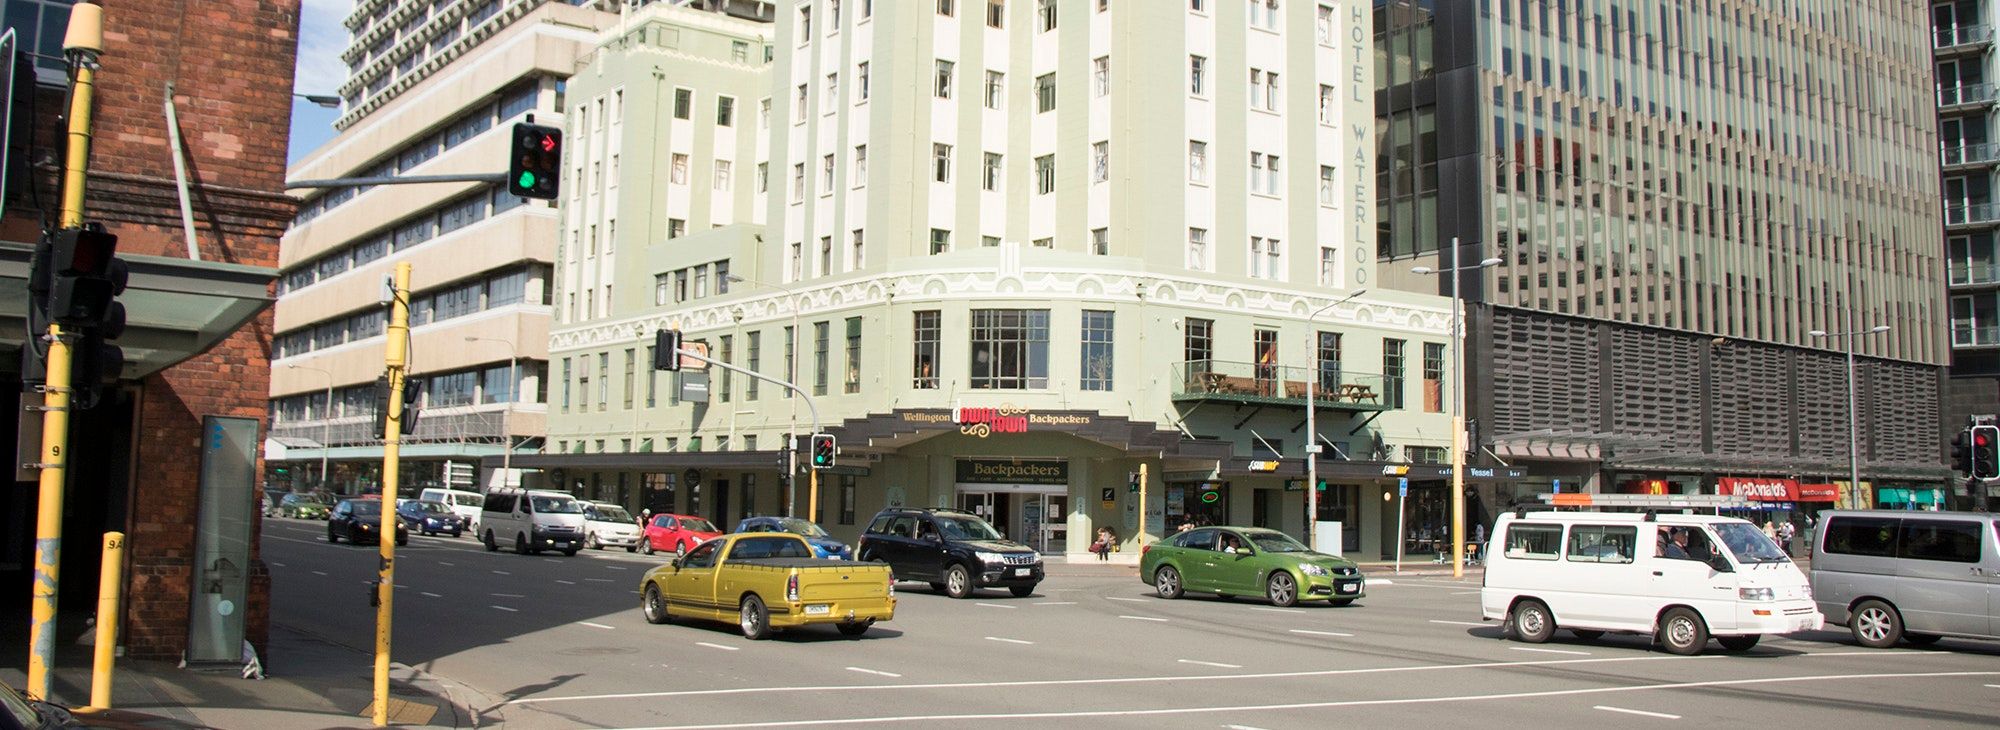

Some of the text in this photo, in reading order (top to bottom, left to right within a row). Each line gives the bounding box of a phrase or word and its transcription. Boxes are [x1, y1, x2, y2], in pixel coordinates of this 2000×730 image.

[1352, 5, 1367, 285] HOTEL WATERLOO
[554, 106, 572, 321] HOTEL WATERLOO
[903, 412, 950, 423] Wellington
[1030, 413, 1090, 425] Backpackers
[53, 446, 60, 456] 9
[974, 462, 1060, 477] Backpackers
[1471, 467, 1494, 477] Vessel
[1733, 481, 1787, 498] McDonald's
[108, 540, 123, 550] 9A
